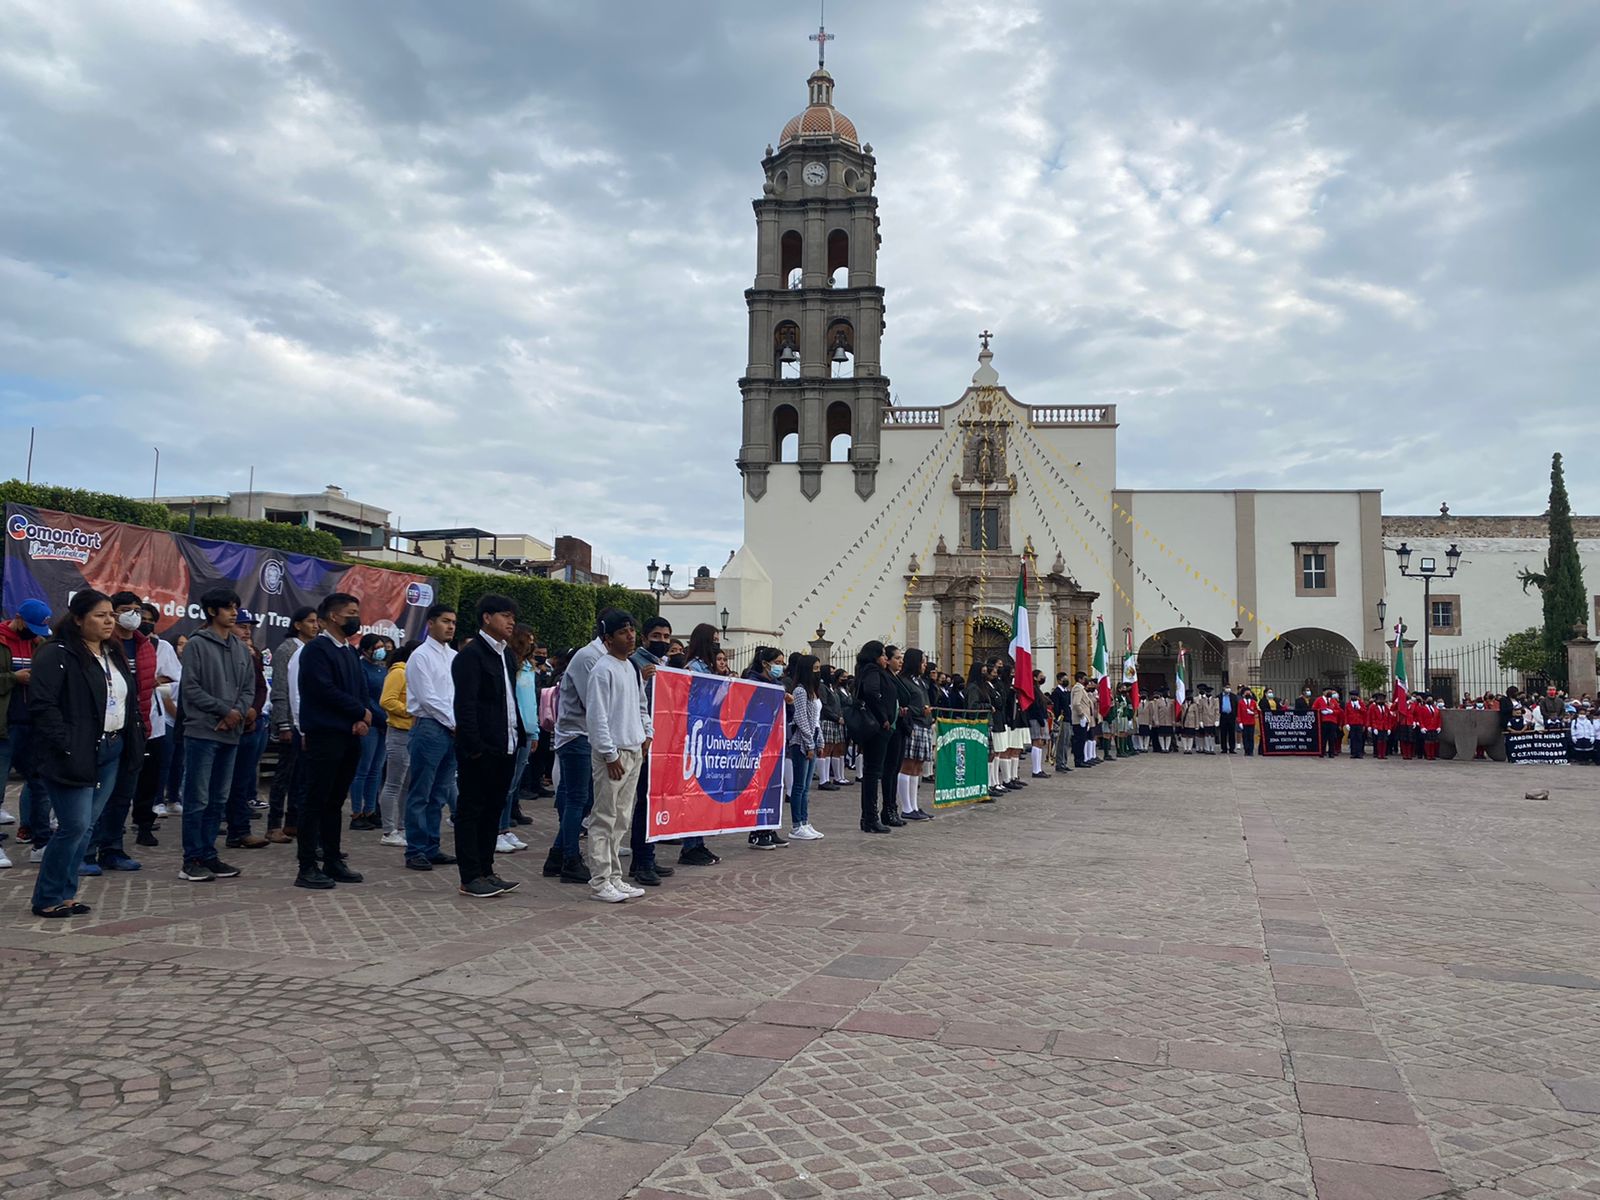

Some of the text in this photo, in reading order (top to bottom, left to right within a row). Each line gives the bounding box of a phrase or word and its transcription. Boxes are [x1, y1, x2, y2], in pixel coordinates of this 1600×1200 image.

[7, 514, 101, 549] Comonfort
[164, 600, 185, 618] de
[254, 613, 266, 628] y
[1269, 722, 1313, 730] TRESGUERRAS
[706, 735, 752, 751] Universidad
[705, 751, 762, 769] Intercultural
